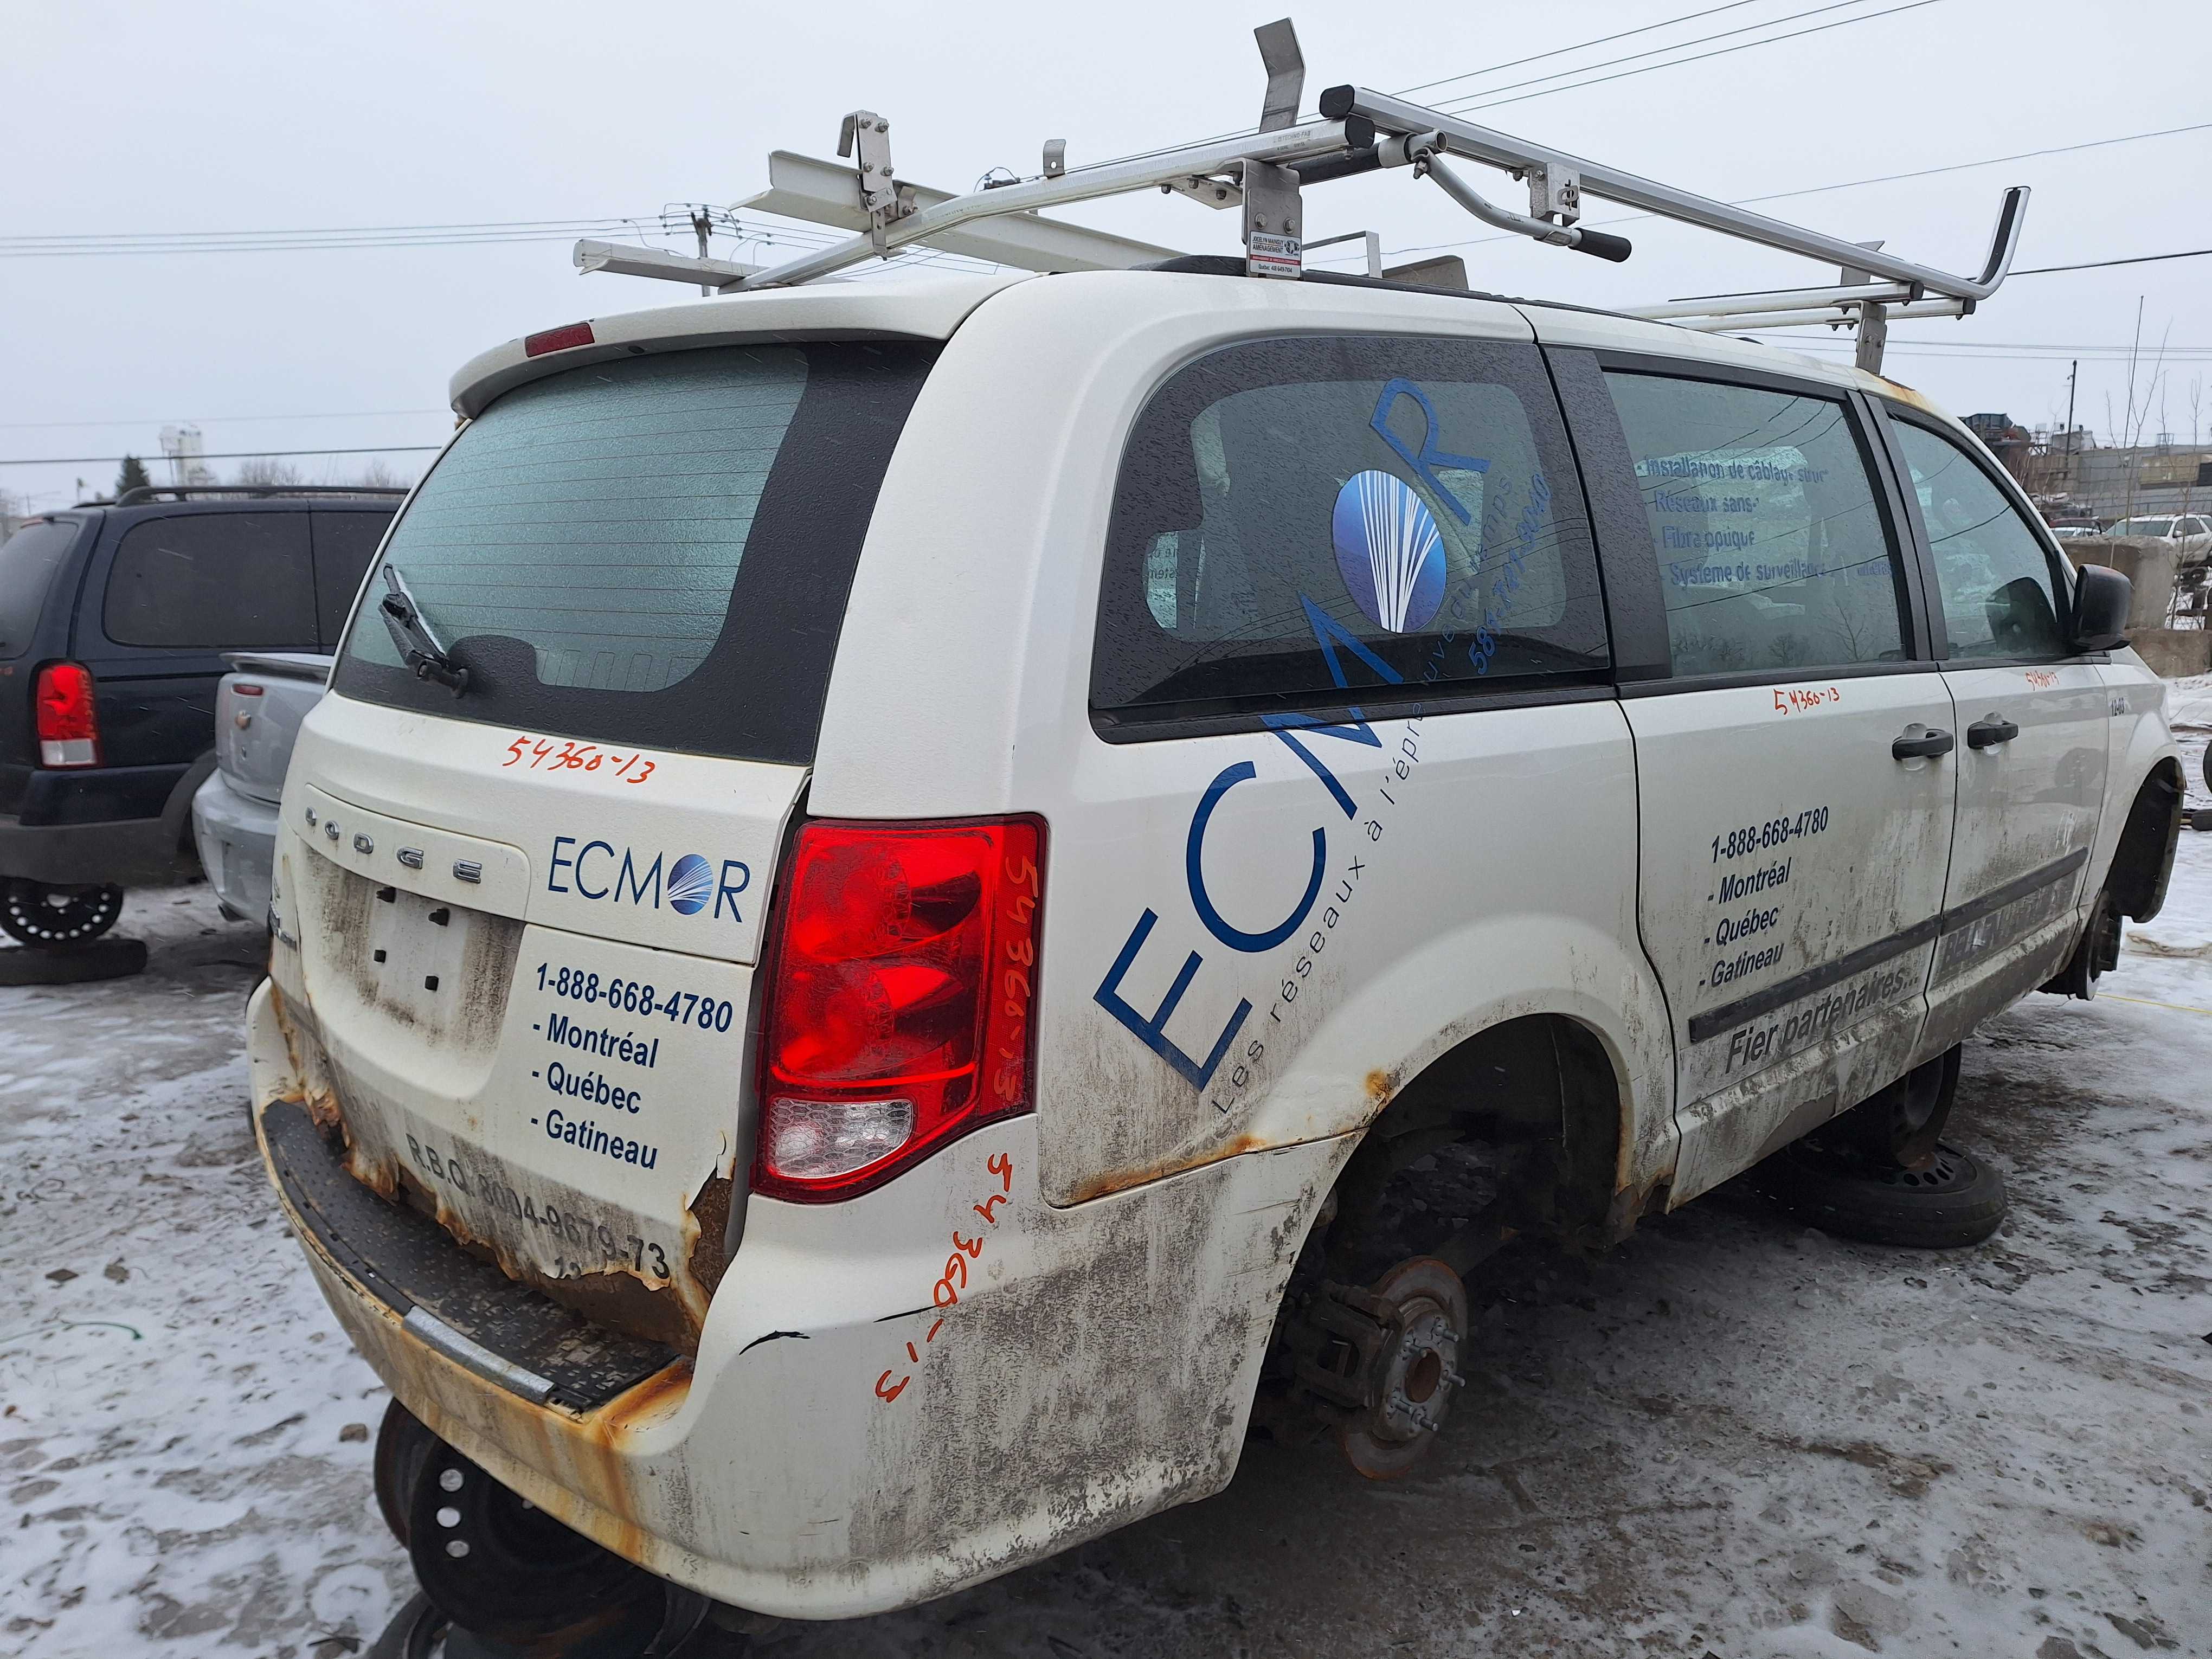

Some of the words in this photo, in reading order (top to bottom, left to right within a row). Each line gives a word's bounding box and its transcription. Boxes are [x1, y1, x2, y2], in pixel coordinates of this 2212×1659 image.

[502, 735, 656, 783] 54360-13
[305, 806, 483, 884] DODGE
[1711, 806, 1829, 864] 1-888-668-4780
[1719, 856, 1792, 905] Montréal
[1716, 906, 1779, 947] Québec
[1212, 1040, 1264, 1114] Les
[1270, 854, 1366, 1023] réseaux
[1364, 820, 1383, 842] à
[1711, 942, 1785, 988] Gatineau
[536, 962, 734, 1033] 1-888-668-4780
[546, 1012, 660, 1069] Montréal
[1725, 1023, 1779, 1075] Fier
[547, 1061, 642, 1114] Québec
[546, 1109, 659, 1170] Gatineau
